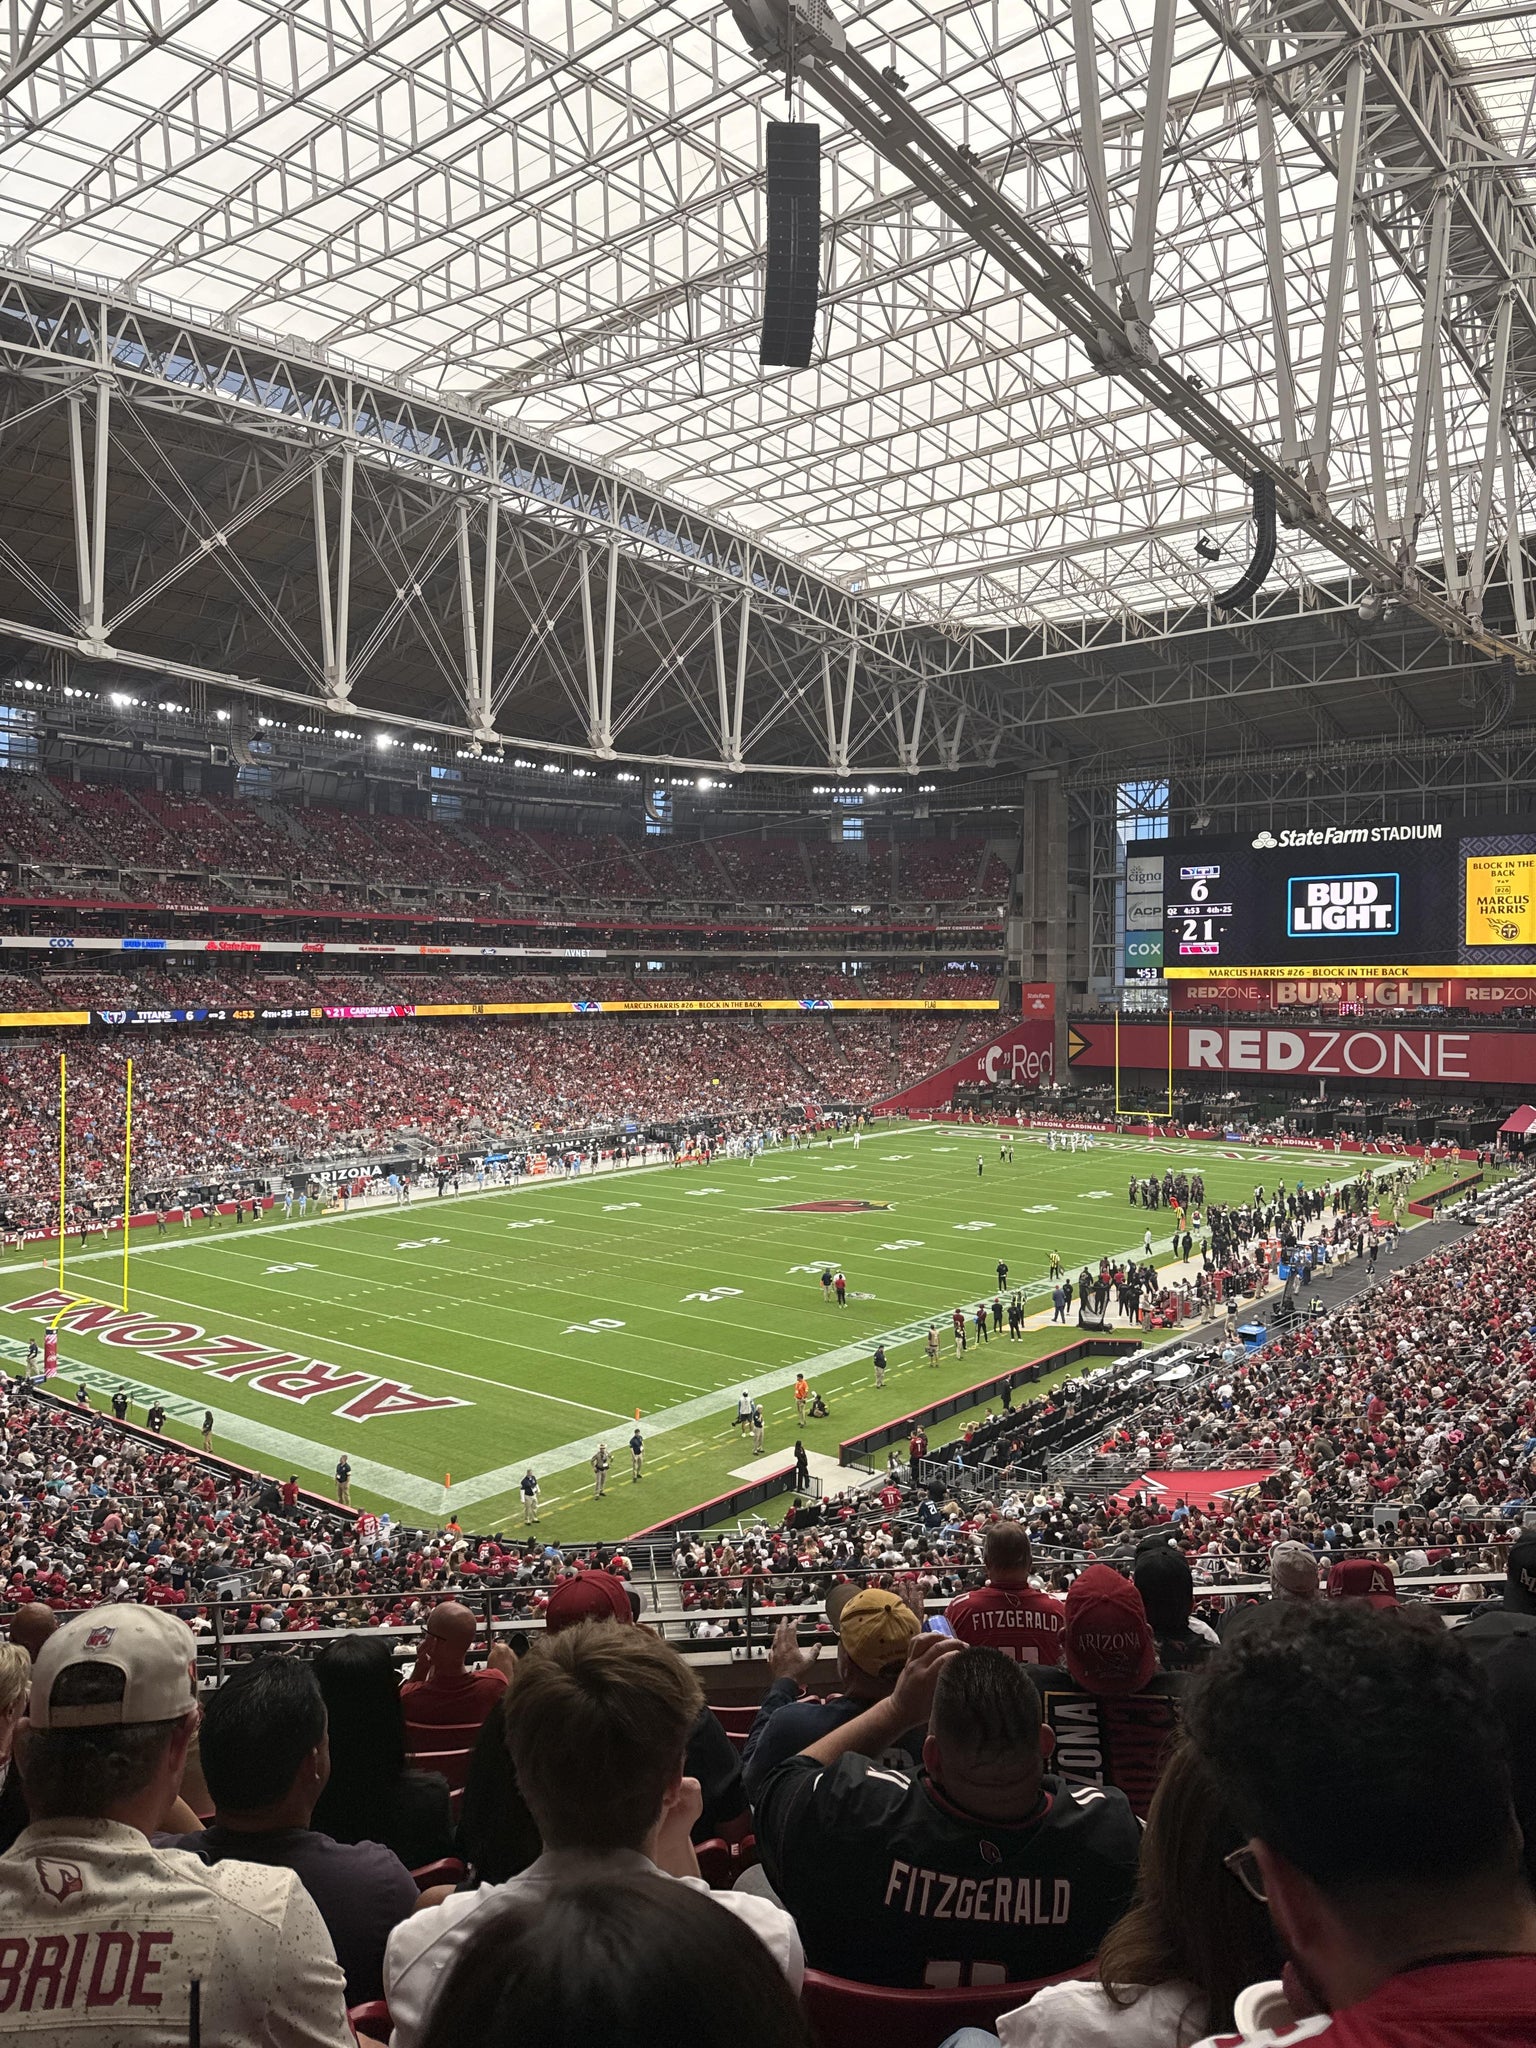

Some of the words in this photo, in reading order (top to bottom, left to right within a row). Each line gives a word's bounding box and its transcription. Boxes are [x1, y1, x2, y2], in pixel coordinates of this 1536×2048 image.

[1371, 823, 1442, 841] STADIUM
[1473, 861, 1502, 869] BLOCK
[1128, 871, 1161, 884] cigna
[1491, 869, 1515, 877] BACK
[1191, 879, 1208, 901] 6
[1307, 880, 1379, 906] BUD
[1476, 895, 1530, 905] MARCUS
[1134, 907, 1161, 916] ACP
[1183, 907, 1200, 915] 4:53
[1480, 904, 1526, 914] HARRIS
[1182, 919, 1213, 941] 21
[49, 938, 75, 948] COX
[1128, 943, 1161, 956] COX
[564, 949, 591, 958] AVNET
[1136, 968, 1158, 978] 4:53
[1208, 968, 1248, 977] MARCUS
[1249, 968, 1285, 977] HARRIS
[1286, 968, 1305, 977] #26
[1312, 968, 1346, 976] BLOCK
[1347, 968, 1358, 976] IN
[1360, 968, 1379, 976] THE
[1381, 967, 1409, 976] BACK
[1187, 986, 1258, 999] REDZONE
[1277, 981, 1342, 1005] BUD
[137, 1011, 172, 1019] TITANS
[185, 1011, 194, 1020] 6
[232, 1010, 255, 1019] 4:53
[333, 1007, 344, 1016] 21
[350, 1007, 392, 1015] CARDINALS
[472, 1005, 484, 1014] FLAG
[1187, 1028, 1470, 1078] REDZONE
[1066, 1123, 1106, 1131] CARDINALS
[309, 1165, 383, 1183] ARIZONA
[952, 1221, 997, 1231] 50
[880, 1239, 926, 1251] 40
[789, 1260, 842, 1274] 30
[686, 1286, 745, 1302] 20
[566, 1318, 627, 1334] 10
[0, 1287, 477, 1424] ARIZONA
[1368, 1569, 1389, 1592] A
[971, 1609, 1058, 1633] FITZGERALD
[1078, 1630, 1142, 1652] ARIZONA
[884, 1858, 1072, 1926] FITZGERALD
